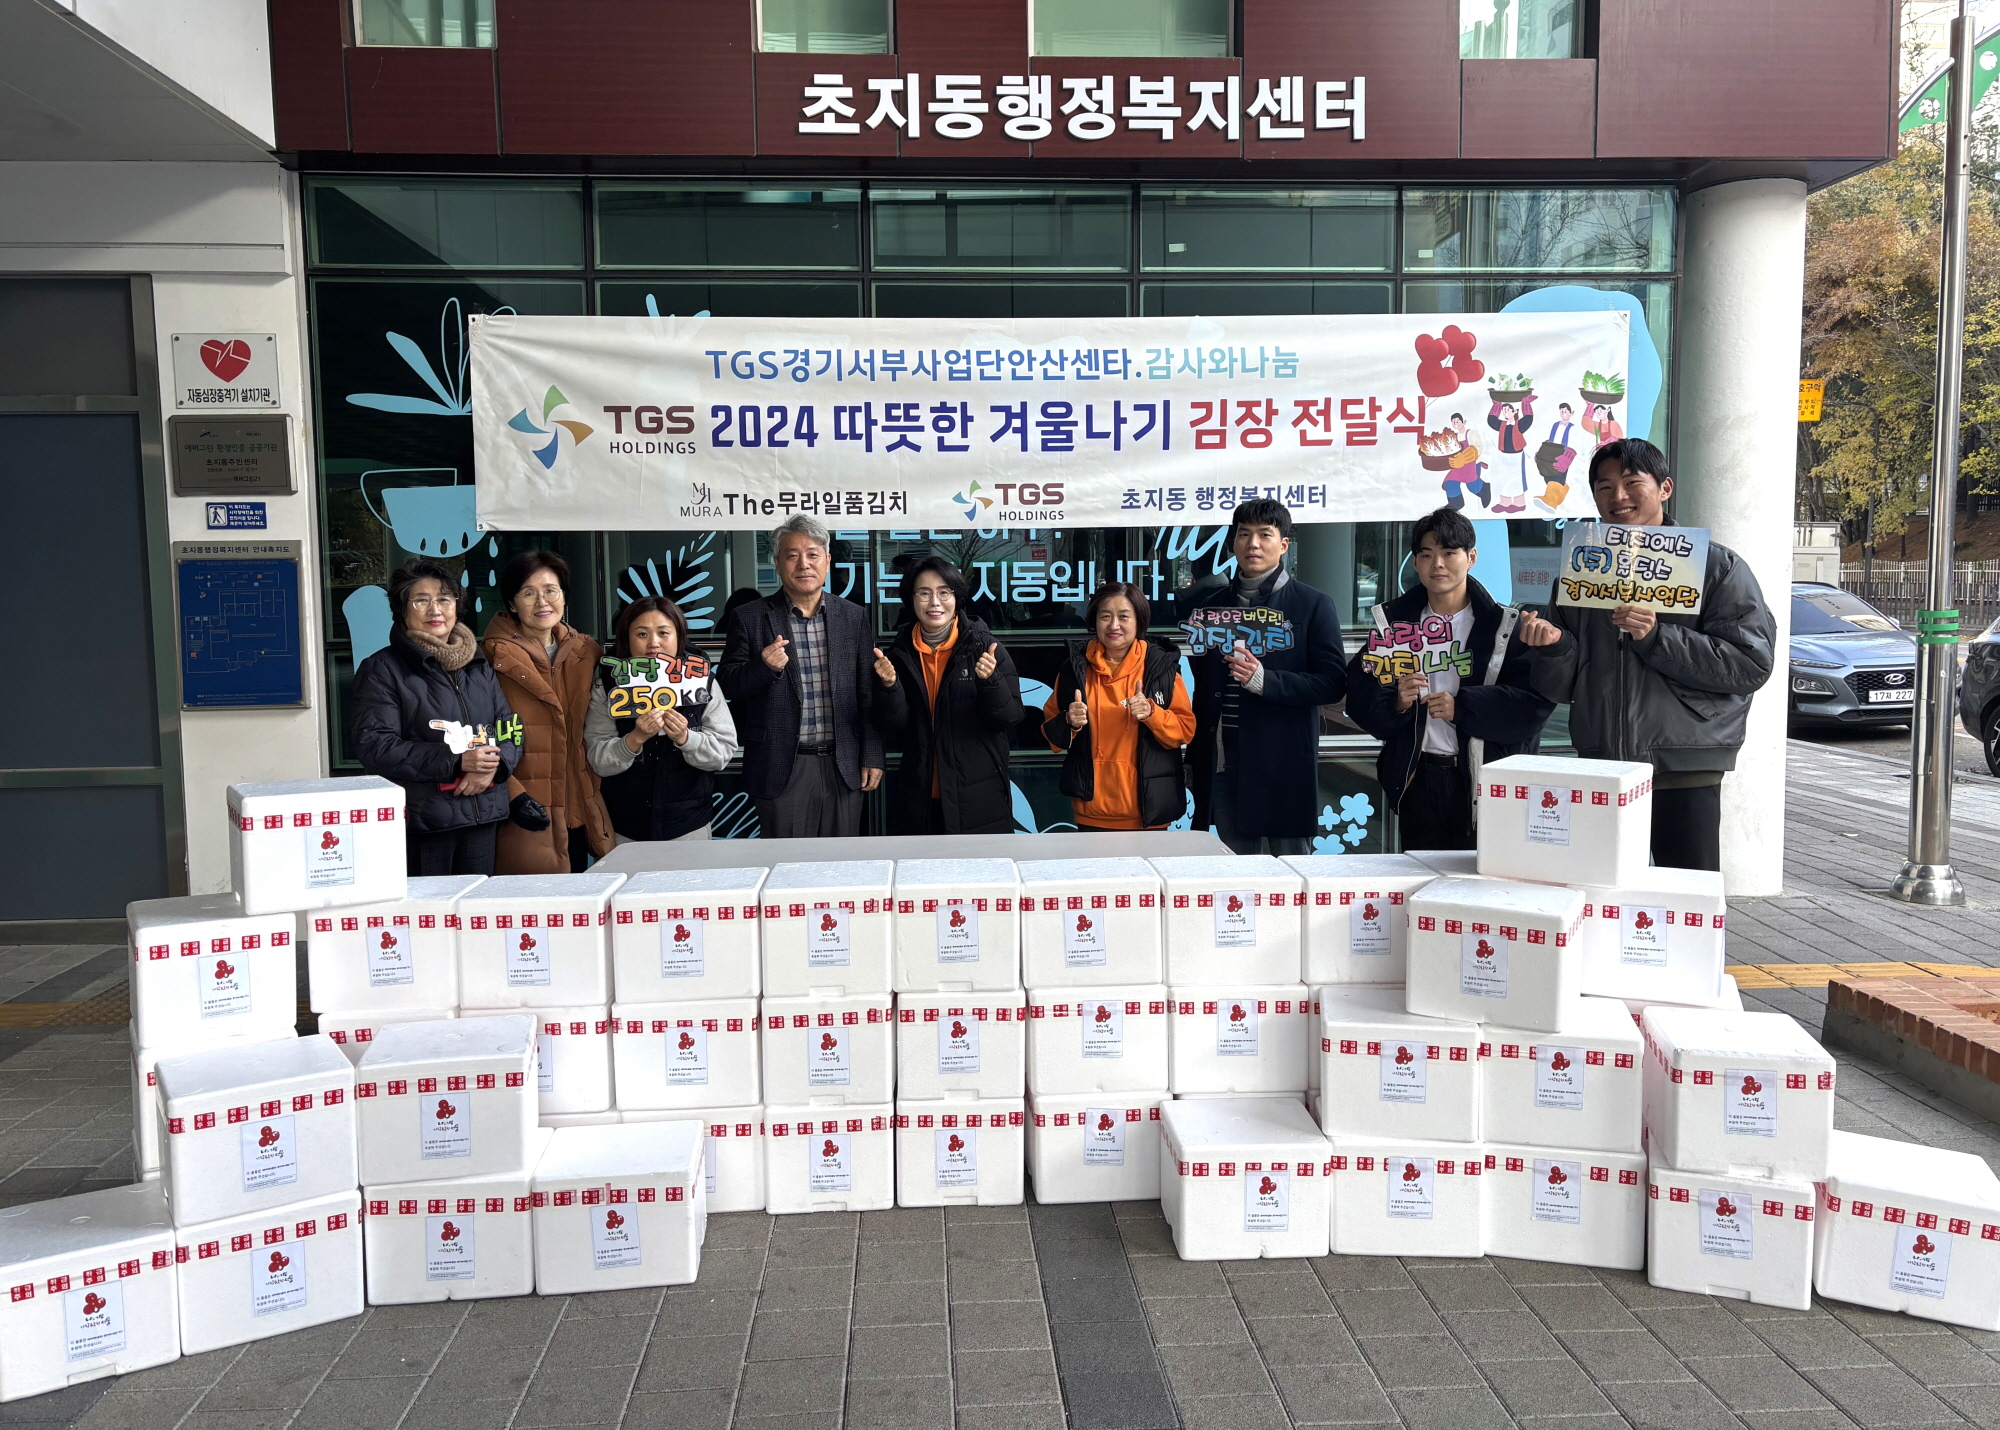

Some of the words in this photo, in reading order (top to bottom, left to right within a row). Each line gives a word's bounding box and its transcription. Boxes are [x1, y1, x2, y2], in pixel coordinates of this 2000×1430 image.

[799, 73, 1366, 141] 초지동행정복지센터
[187, 388, 239, 402] 자동심장충격기
[241, 388, 271, 402] 설치기관
[603, 405, 696, 435] TGS
[710, 404, 819, 448] 2024
[833, 401, 974, 453] 따뜻한
[988, 400, 1171, 453] 겨울나기
[1188, 397, 1279, 450] 김장
[1290, 395, 1427, 447] 전달식
[609, 441, 697, 455] HOLDINGS
[995, 482, 1065, 505] TGS
[1120, 488, 1187, 512] 초지동
[680, 506, 723, 518] MURA
[999, 510, 1065, 522] HOLDINGS
[1572, 545, 1613, 574] (주)
[1561, 578, 1700, 608] 경기서부사업단
[1369, 616, 1454, 652] 사랑의
[1895, 691, 1913, 700] 227
